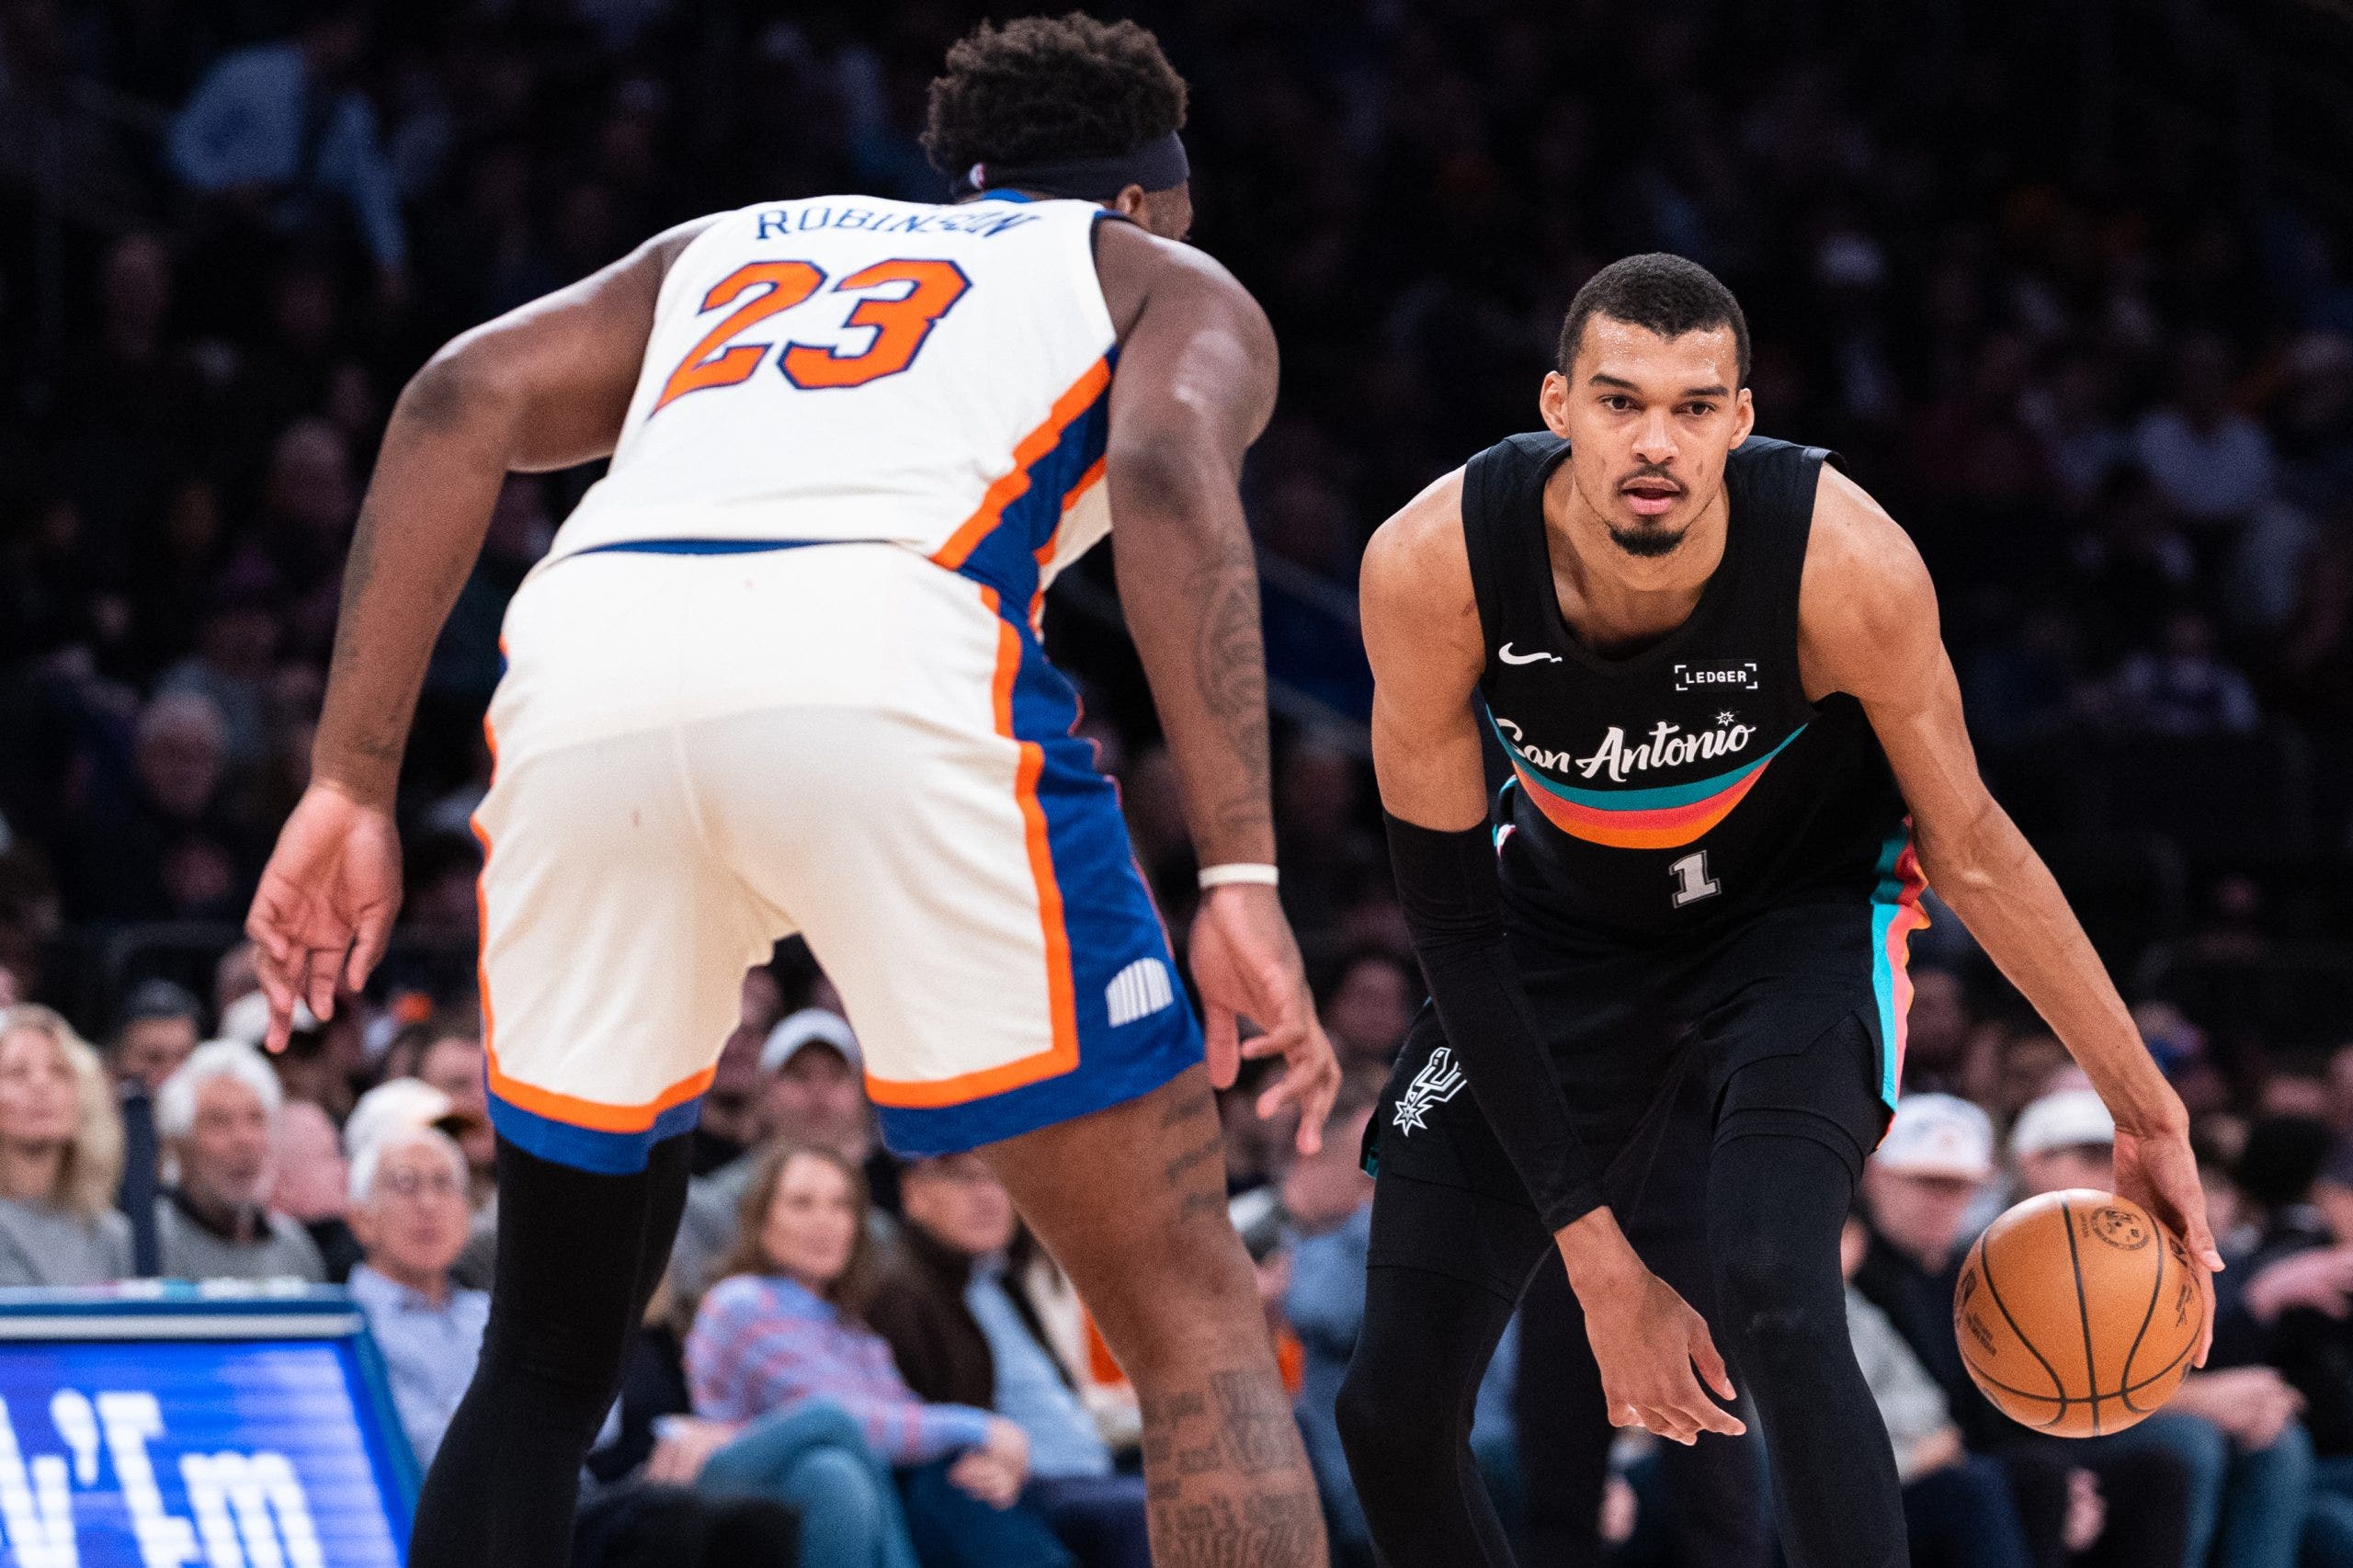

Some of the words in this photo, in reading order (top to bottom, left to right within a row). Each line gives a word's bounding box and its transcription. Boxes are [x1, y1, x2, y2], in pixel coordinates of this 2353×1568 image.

[647, 258, 972, 420] 23
[1686, 670, 1747, 685] LEDGER
[1575, 721, 1756, 783] Antonio
[1668, 849, 1722, 909] 1
